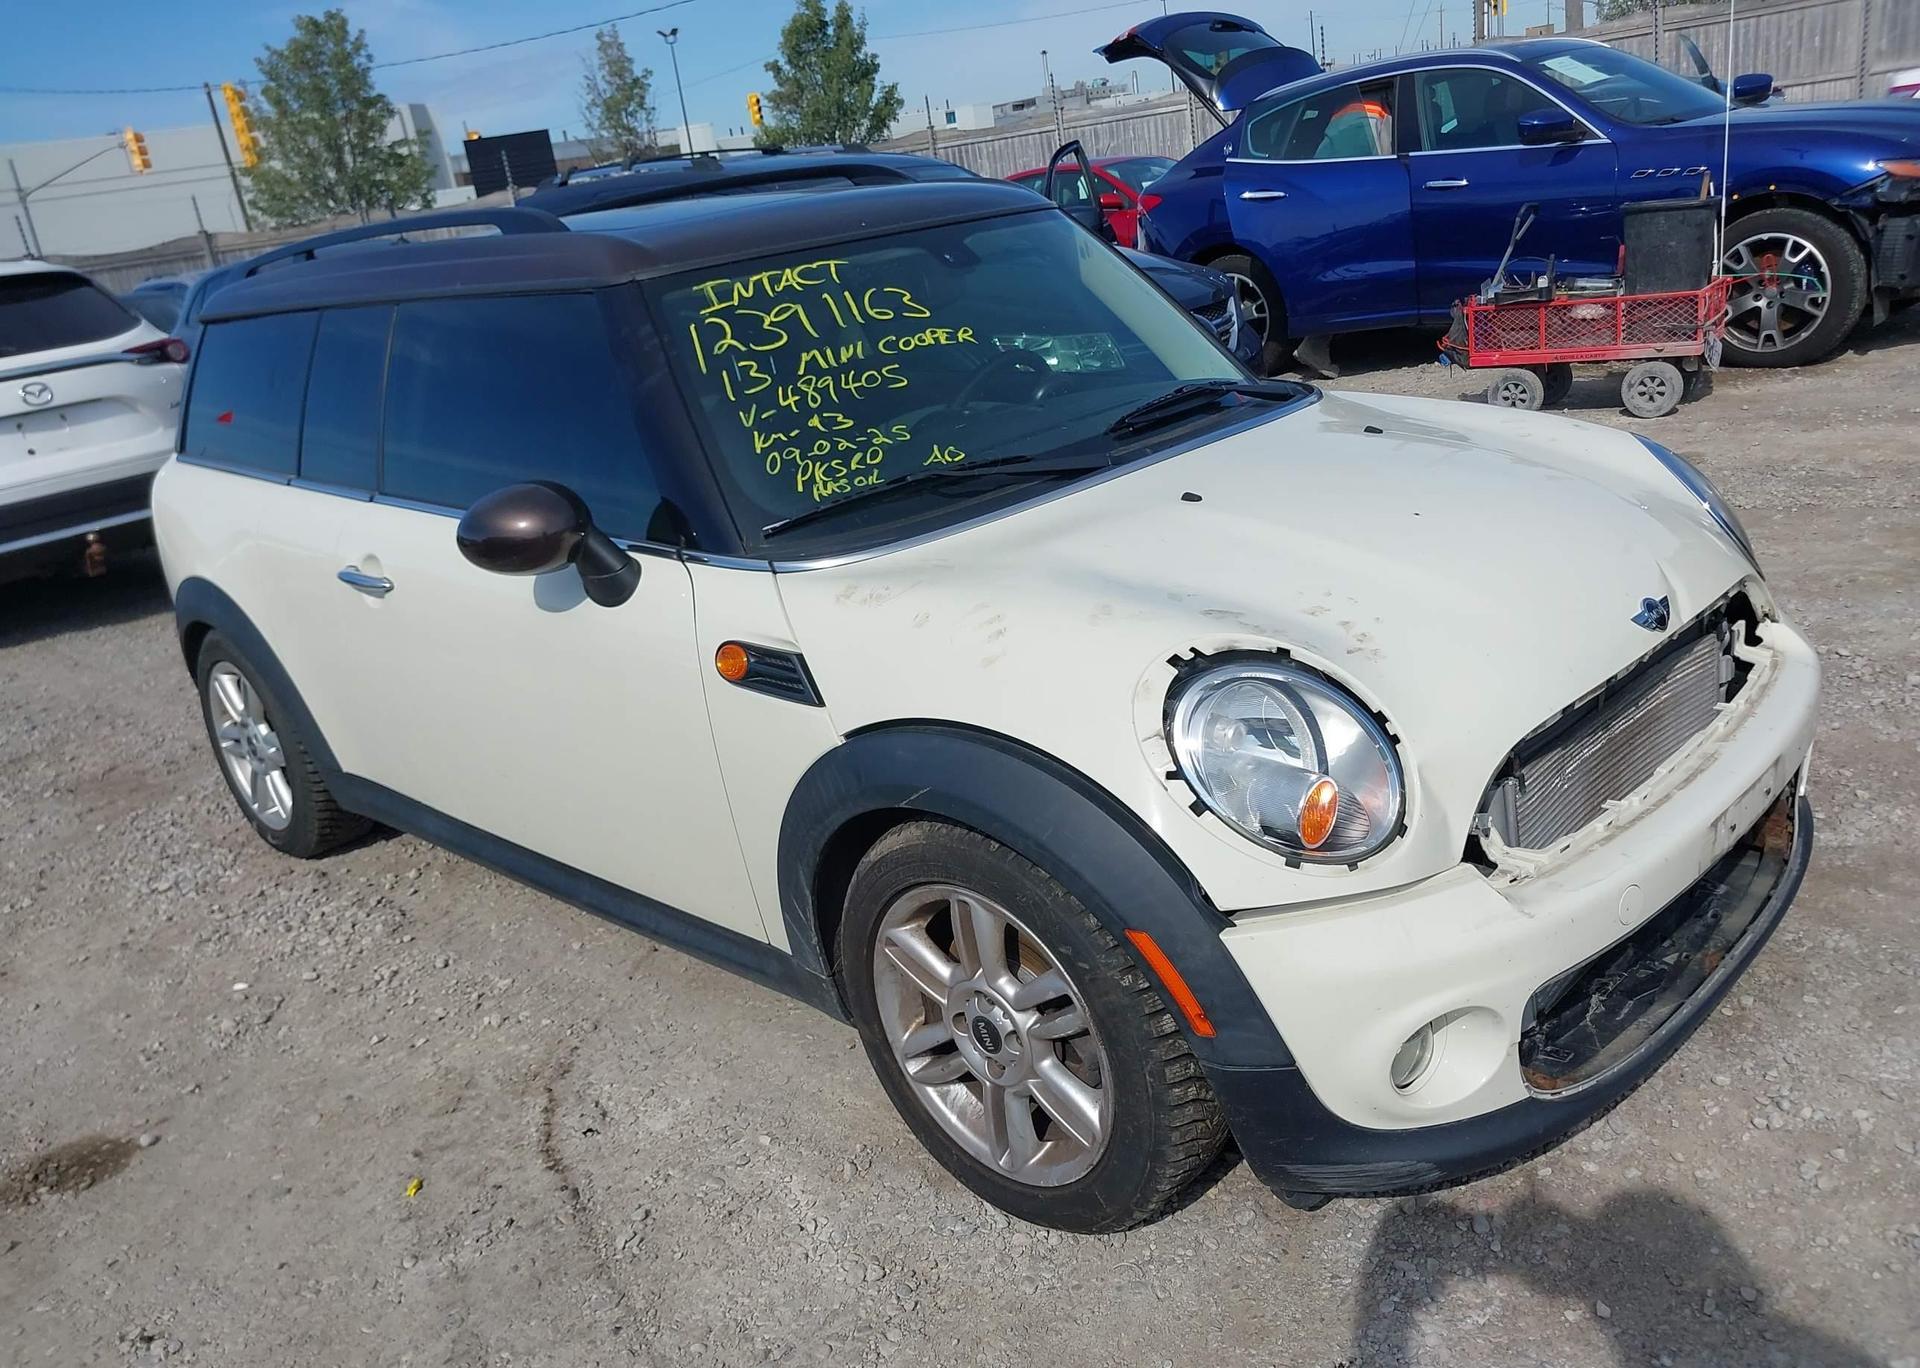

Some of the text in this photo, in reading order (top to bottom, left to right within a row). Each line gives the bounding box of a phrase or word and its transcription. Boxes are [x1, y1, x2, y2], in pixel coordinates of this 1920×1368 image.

[693, 259, 849, 315] INTACT
[689, 287, 931, 374] 12391163
[797, 340, 865, 376] MINI
[877, 326, 979, 355] COOPER
[977, 1022, 995, 1049] MINI
